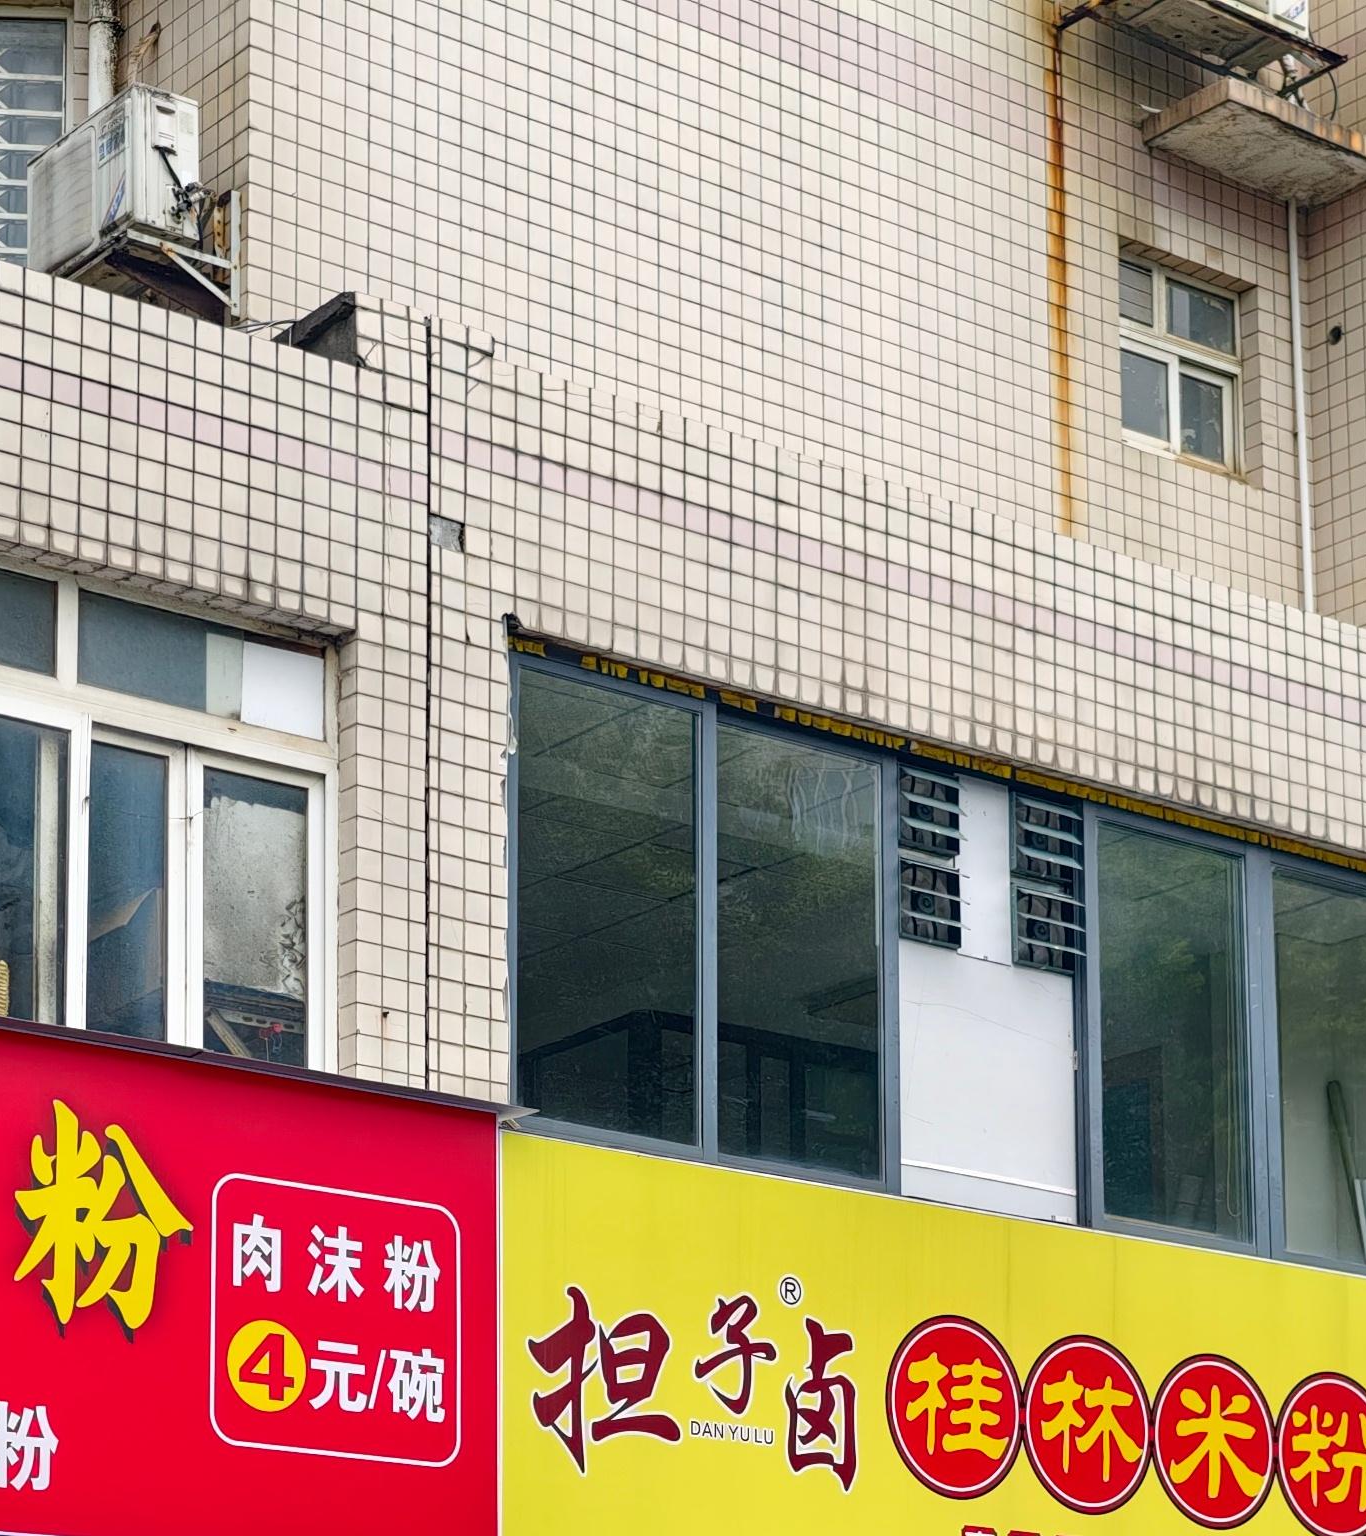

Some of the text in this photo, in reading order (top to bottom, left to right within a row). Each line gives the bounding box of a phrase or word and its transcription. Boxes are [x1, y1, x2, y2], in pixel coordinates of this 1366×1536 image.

[231, 1213, 441, 1314] 肉沫粉
[231, 1322, 447, 1424] 4元/碗
[527, 1286, 858, 1491] 担子卤
